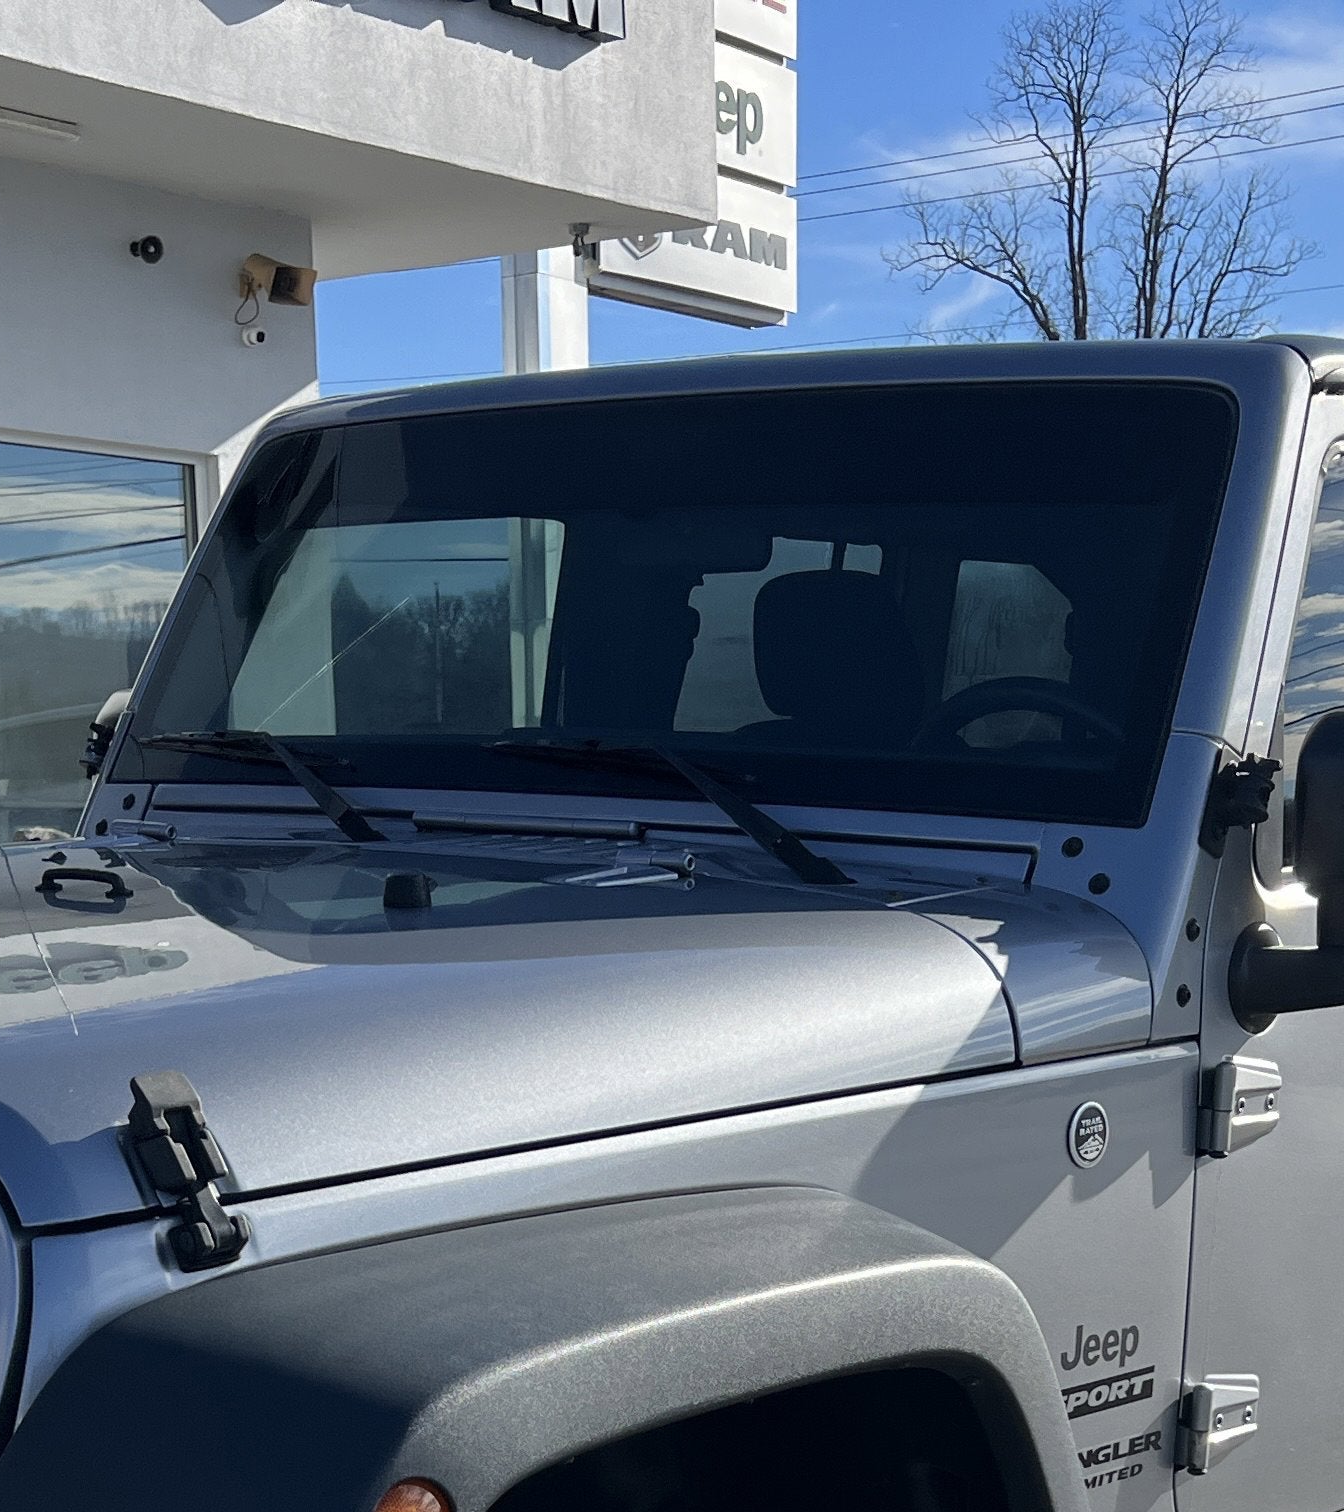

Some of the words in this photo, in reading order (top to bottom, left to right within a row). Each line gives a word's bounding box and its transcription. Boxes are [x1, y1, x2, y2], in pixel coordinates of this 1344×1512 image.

[1079, 1123, 1104, 1137] RATED
[1081, 1116, 1103, 1128] TRAIL
[1060, 1324, 1140, 1371] Jeep
[1062, 1371, 1155, 1415] PORT
